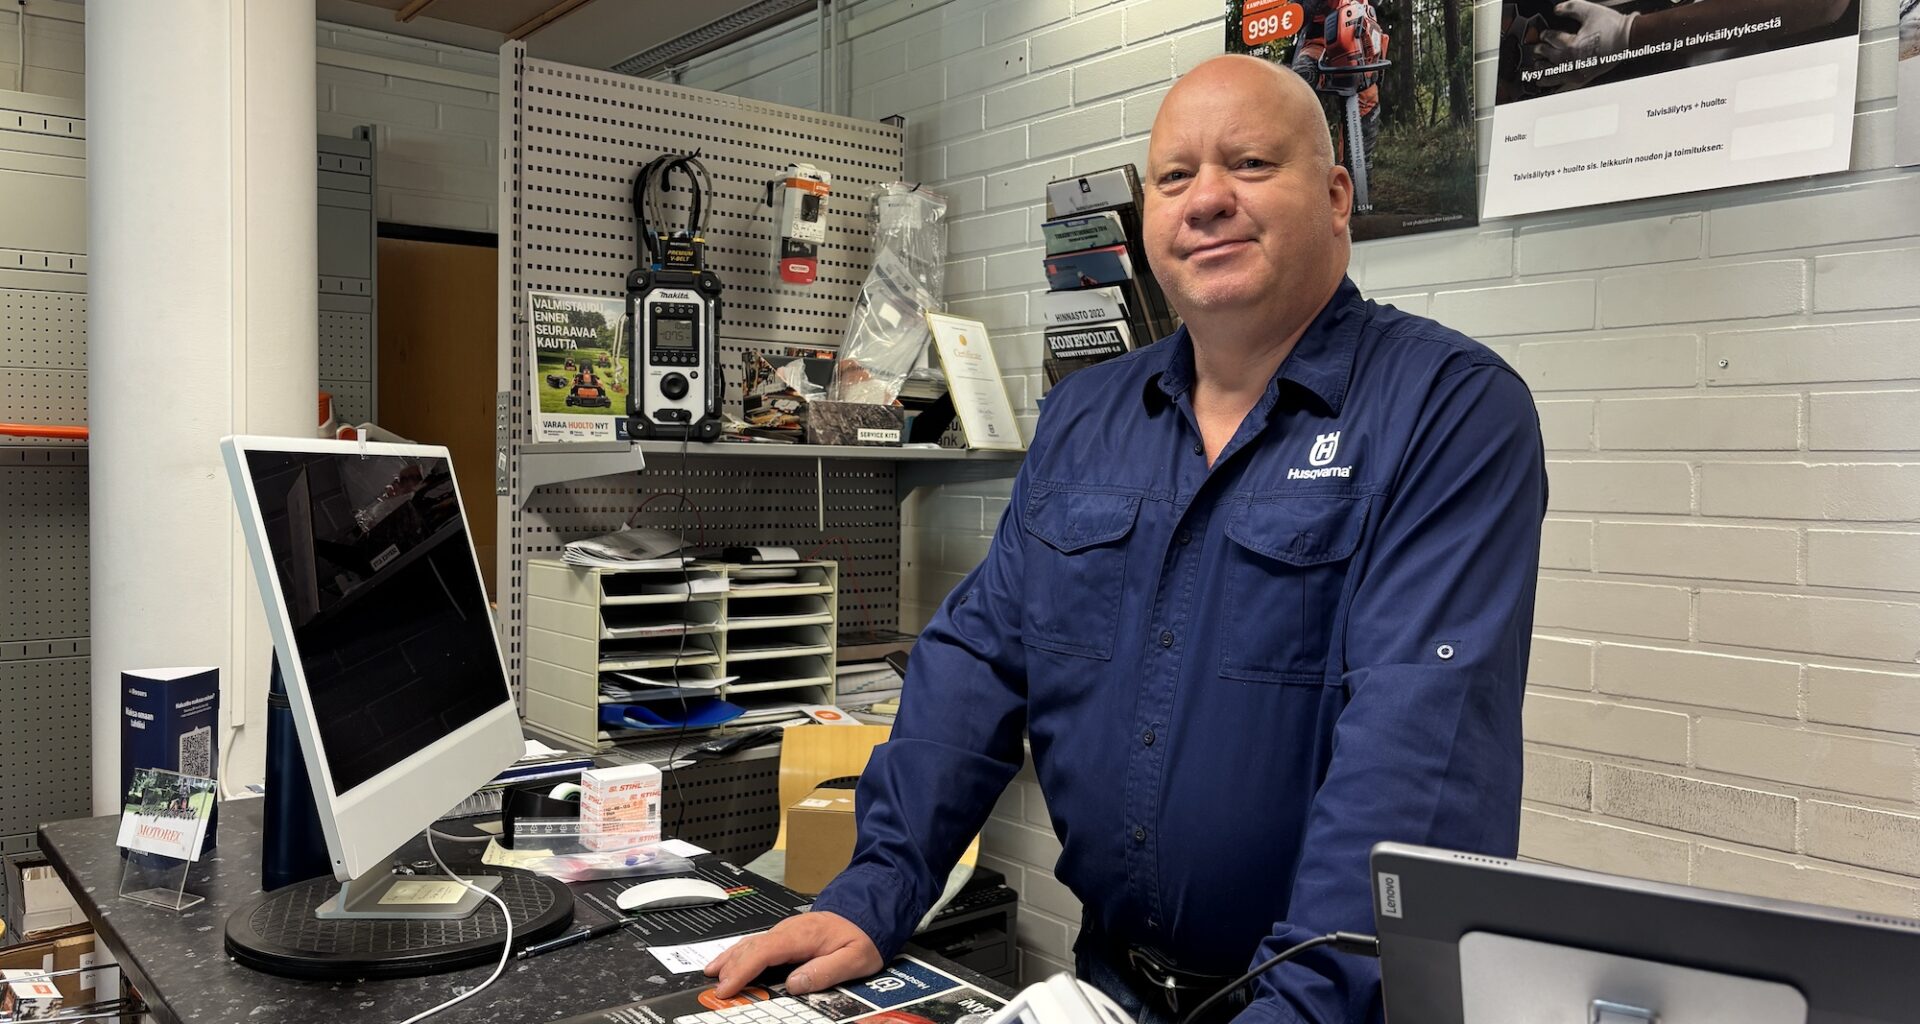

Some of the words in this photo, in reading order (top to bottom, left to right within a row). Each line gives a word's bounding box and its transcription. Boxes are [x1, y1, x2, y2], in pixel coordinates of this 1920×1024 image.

[1248, 15, 1278, 39] 999
[1281, 11, 1293, 30] €
[1521, 69, 1543, 82] Kysy
[1544, 61, 1574, 76] meiltä
[1575, 56, 1598, 70] lisää
[1600, 43, 1672, 64] vuosihuollosta
[1672, 38, 1684, 51] ja
[1685, 16, 1782, 47] talvisäilytyksestä
[1646, 103, 1693, 117] Talvisäilytys
[1700, 97, 1728, 109] huolto:
[1504, 133, 1528, 142] Huolto:
[1513, 168, 1555, 182] Talvisäilytys
[1562, 164, 1586, 174] huolto
[1586, 161, 1599, 171] sis.
[1600, 155, 1633, 168] leikkurin
[1634, 152, 1663, 163] noudon
[1664, 150, 1673, 160] ja
[1674, 143, 1724, 157] toimituksen:
[667, 249, 694, 257] PREMIUM
[670, 255, 690, 263] V-BELT
[659, 291, 690, 300] makita
[533, 298, 604, 314] VALMISTAUDU
[535, 311, 569, 324] ENNEN
[1055, 311, 1088, 323] HINNASTO
[1088, 307, 1106, 319] 2023
[535, 323, 598, 339] SEURAAVAA
[537, 336, 578, 350] KAUTTA
[1048, 329, 1121, 350] KONETOIMI
[543, 420, 567, 429] VARAA
[568, 421, 594, 430] HUOLTO
[595, 422, 609, 430] NYT
[860, 431, 884, 439] SERVICE
[1287, 465, 1352, 480] Husqvarna
[619, 782, 642, 791] STIHL
[1385, 876, 1397, 914] Lenovo
